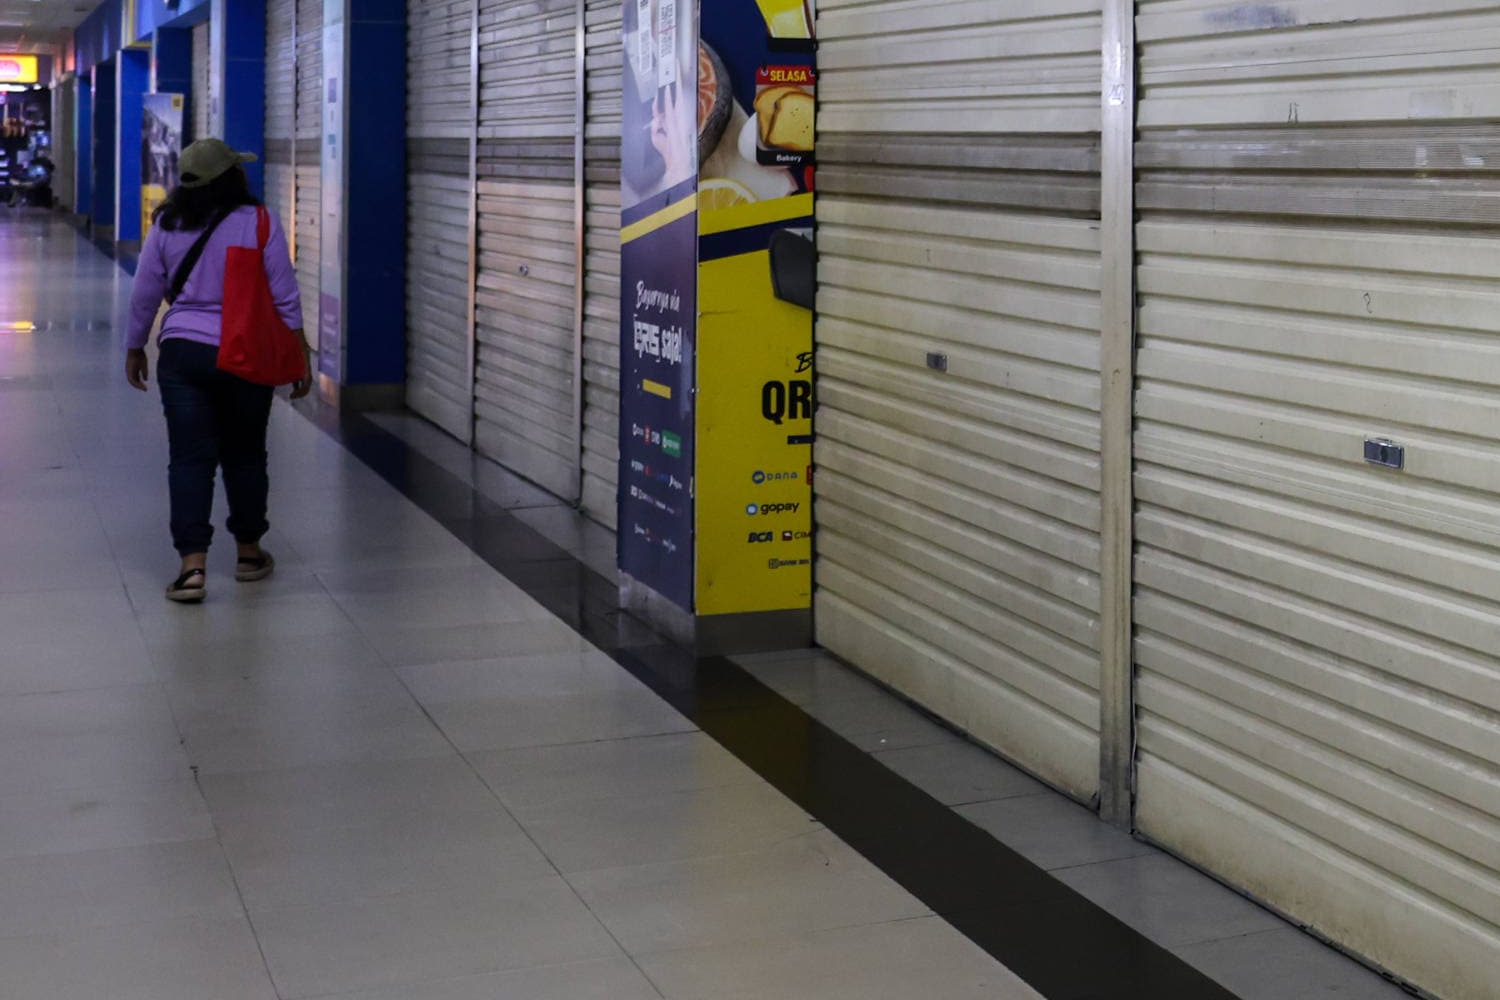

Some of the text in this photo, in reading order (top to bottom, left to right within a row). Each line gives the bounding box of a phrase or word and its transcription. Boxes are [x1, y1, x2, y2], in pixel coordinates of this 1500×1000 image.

[770, 69, 807, 83] SELASA
[776, 153, 802, 164] Bakery
[760, 502, 799, 516] gopay
[747, 531, 773, 543] BCA
